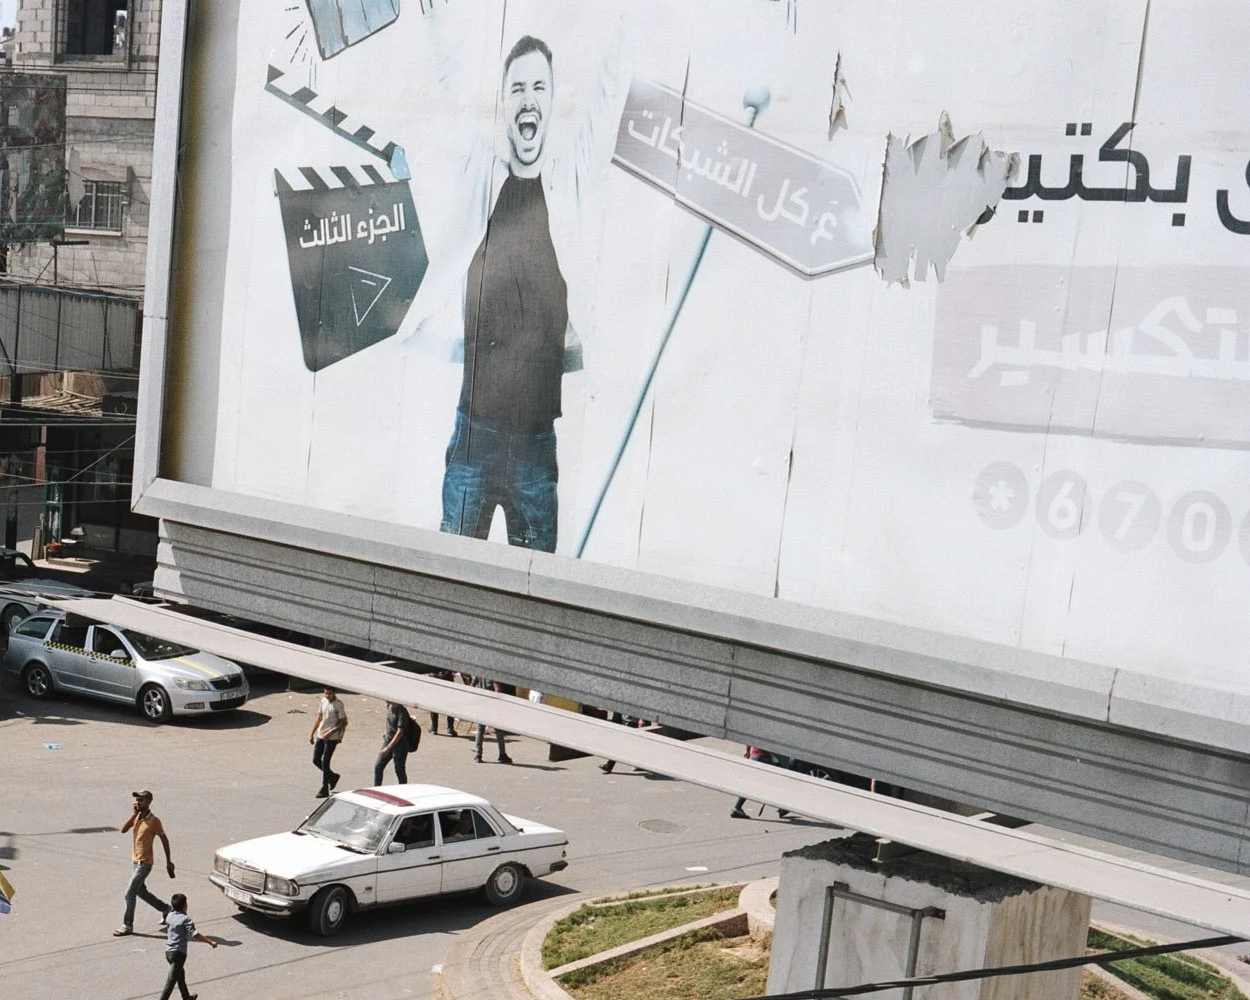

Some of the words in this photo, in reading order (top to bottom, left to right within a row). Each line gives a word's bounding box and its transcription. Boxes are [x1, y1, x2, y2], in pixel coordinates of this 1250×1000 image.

[627, 109, 758, 199] الشبكات
[975, 122, 1192, 227] بكتي
[298, 211, 353, 249] الثالث
[356, 202, 406, 245] الجزء
[757, 179, 809, 227] كل
[967, 296, 1250, 388] تكسير
